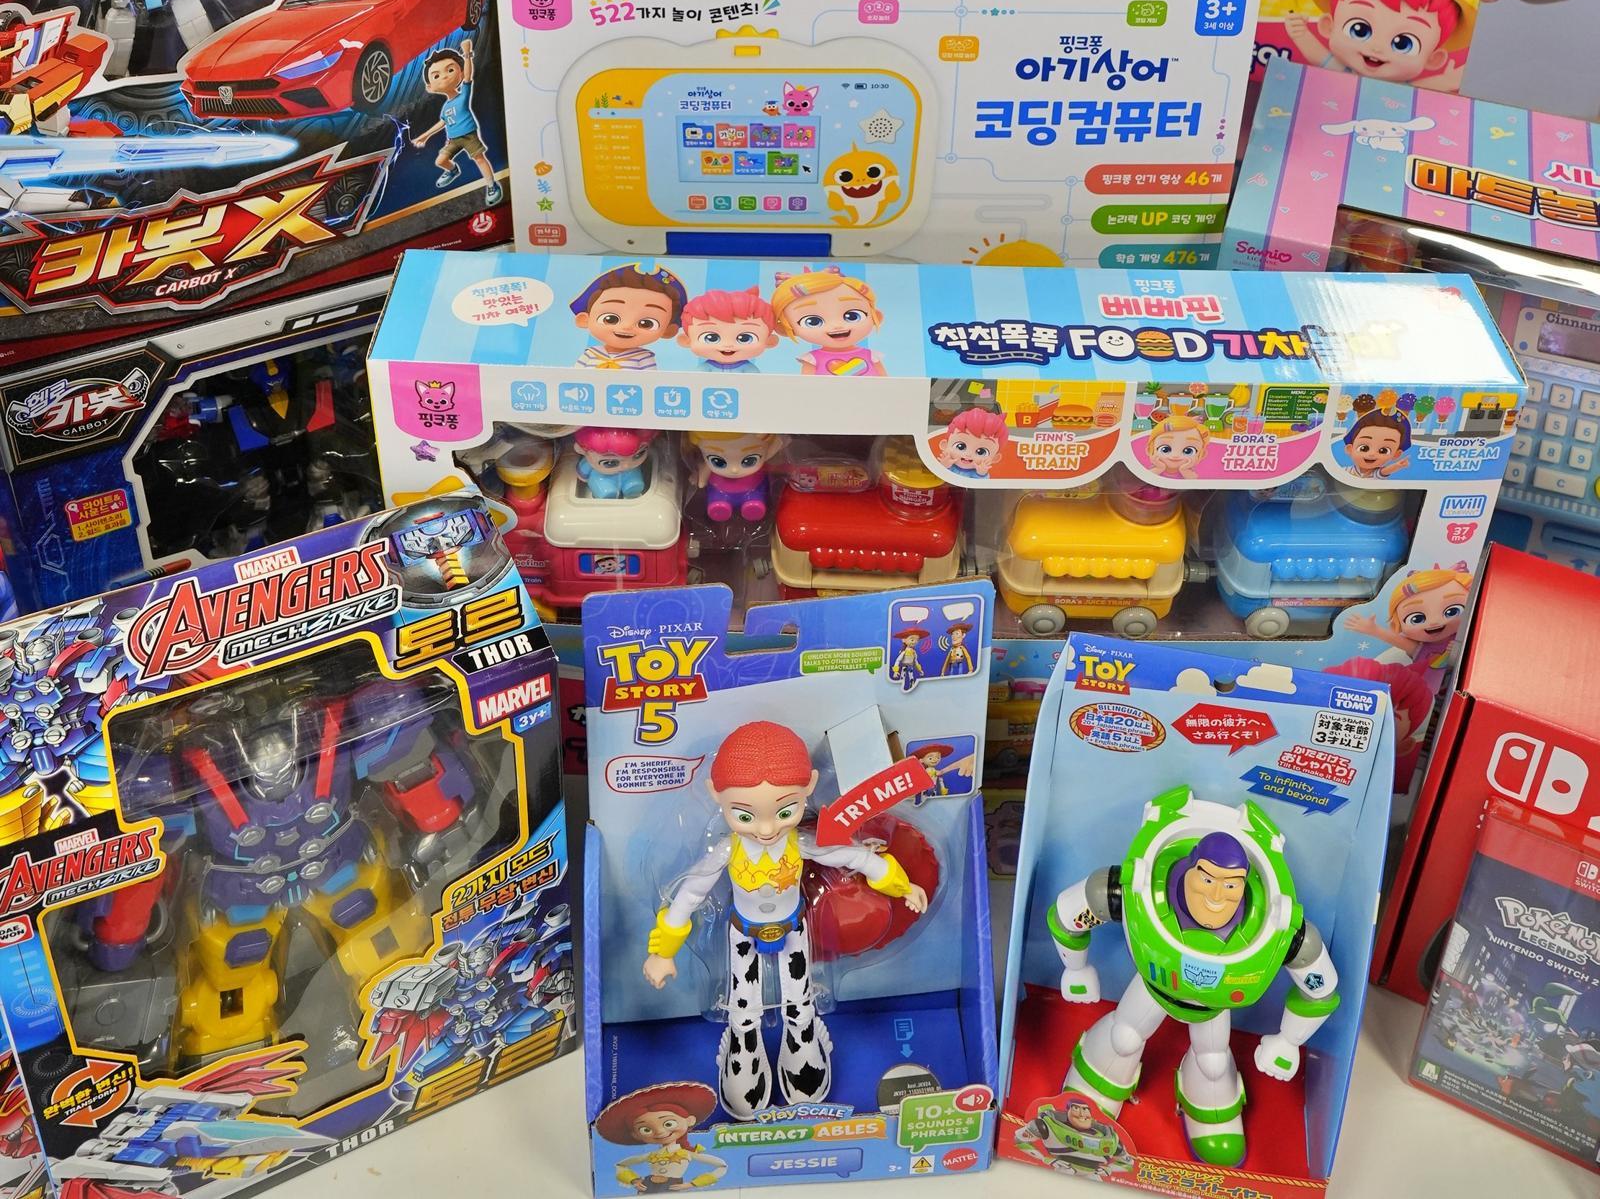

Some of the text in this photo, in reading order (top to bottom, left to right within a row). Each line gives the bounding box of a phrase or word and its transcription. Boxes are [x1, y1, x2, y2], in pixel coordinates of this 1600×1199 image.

[528, 7, 557, 21] 핑크퐁
[589, 1, 759, 27] 522가지 놀이 콘텐츠!
[1204, 21, 1234, 31] 3세 이상
[1059, 35, 1103, 54] 핑크퐁
[1015, 48, 1169, 91] 아기상어
[680, 100, 731, 112] 코딩컴퓨터
[974, 100, 1202, 146] 코딩컴퓨터
[1102, 171, 1222, 187] 핑크퐁 인기 영상 46개
[1107, 211, 1216, 226] 논리력 UP 코딩 게임
[1116, 249, 1209, 265] 학습 게임 476개
[1236, 240, 1292, 263] Sanrio
[155, 266, 239, 297] CARBOT X
[1134, 278, 1176, 294] 핑크퐁
[483, 294, 523, 309] 맛있는
[1101, 295, 1222, 322] 베베핀
[472, 303, 540, 321] 기차 여행!
[934, 323, 1060, 353] 칙칙폭폭
[27, 379, 69, 417] 헬로
[46, 385, 128, 428] 카봇
[62, 418, 110, 436] CARBOT
[418, 412, 459, 430] 핑크퐁
[1035, 432, 1074, 442] FINN'S
[1233, 435, 1275, 444] BORA'S
[1439, 438, 1486, 447] BRODY'S
[1018, 442, 1088, 456] BURGER
[1226, 444, 1278, 457] JUICE
[1419, 448, 1499, 459] ICE CREAM
[1026, 456, 1079, 470] TRAIN
[1224, 457, 1276, 471] TRAIN
[1434, 460, 1480, 471] TRAIN
[1452, 526, 1469, 536] 37
[239, 549, 296, 581] MARVEL
[135, 542, 389, 681] AVENGERS
[396, 588, 523, 669] 토르
[607, 622, 703, 639] Disney PIXAR
[468, 632, 534, 670] THOR
[1083, 643, 1133, 659] Disney PIXAR
[602, 639, 711, 683] TOY
[1079, 655, 1137, 682] TOY
[615, 682, 697, 701] STORY
[1081, 678, 1126, 692] STORY
[479, 677, 550, 725] MARVEL
[1334, 699, 1373, 712] TOMY
[1335, 690, 1374, 705] TAKARA
[518, 707, 549, 729] 3y+
[1098, 704, 1143, 718] BILINGUAL
[640, 701, 677, 743] 5
[1086, 712, 1151, 731] 日本語20以上
[1318, 720, 1370, 736] 対象年齢
[1315, 731, 1364, 750] 3才以上
[1293, 745, 1351, 767] かたむけて
[631, 765, 686, 775] RESPONSIBLE
[1281, 752, 1356, 780] おしゃべり!
[616, 778, 685, 789] BONNIE'S ROOM!
[634, 772, 674, 781] EVERYONE
[676, 771, 686, 779] IN
[1259, 771, 1271, 781] To
[833, 772, 914, 828] TRY ME!
[1263, 783, 1329, 806] and beyond!
[57, 831, 97, 853] MARVEL
[0, 828, 156, 914] AVENGERS
[453, 839, 550, 907] 2가지 모드
[479, 881, 518, 912] 무장
[521, 864, 555, 893] 변신
[1519, 929, 1588, 966] LEGENDS
[1488, 934, 1544, 963] NINTENDO
[1545, 958, 1590, 982] SWITCH
[64, 1086, 118, 1117] TRANSFORM
[915, 1104, 955, 1121] 10+
[907, 1117, 975, 1131] SOUNDS &
[911, 1126, 969, 1139] PHRASES
[325, 1119, 395, 1160] THOR
[769, 1154, 839, 1171] JESSIE
[942, 1153, 979, 1167] MATTEL
